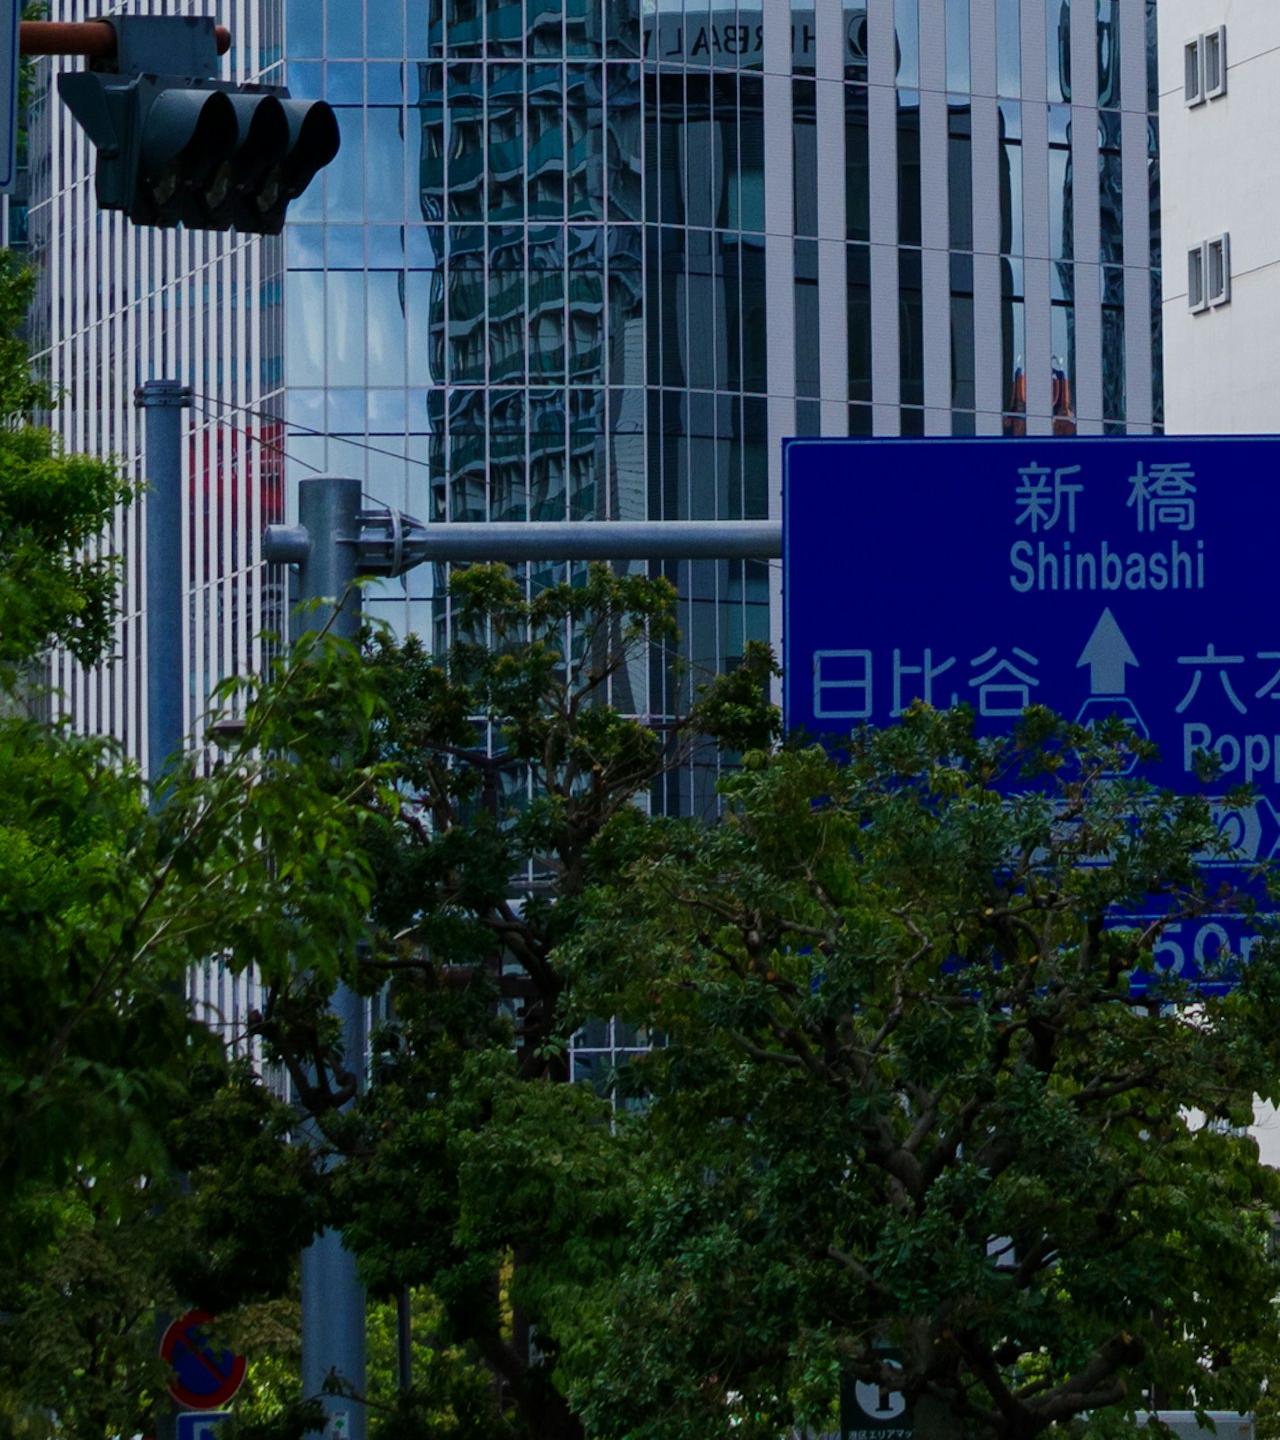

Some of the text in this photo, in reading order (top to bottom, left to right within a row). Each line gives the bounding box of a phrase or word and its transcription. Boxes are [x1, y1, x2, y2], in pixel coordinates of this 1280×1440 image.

[1014, 460, 1197, 533] 新橋
[1009, 540, 1205, 593] Shinbashi
[812, 647, 1040, 719] 日比谷
